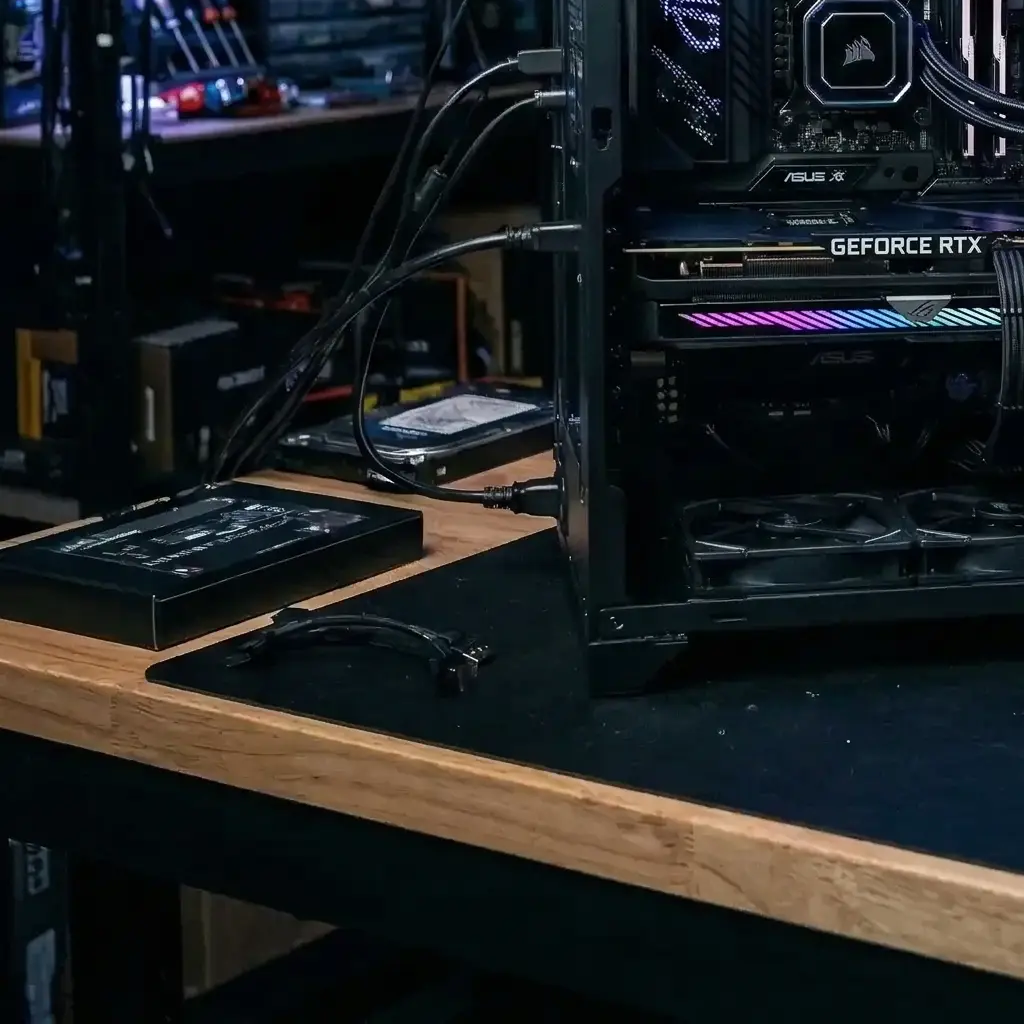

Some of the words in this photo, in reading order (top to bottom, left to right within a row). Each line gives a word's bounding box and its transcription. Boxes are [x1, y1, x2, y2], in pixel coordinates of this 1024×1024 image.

[784, 171, 825, 182] ASUS
[830, 236, 933, 256] GEFORCE
[939, 235, 983, 255] RTX
